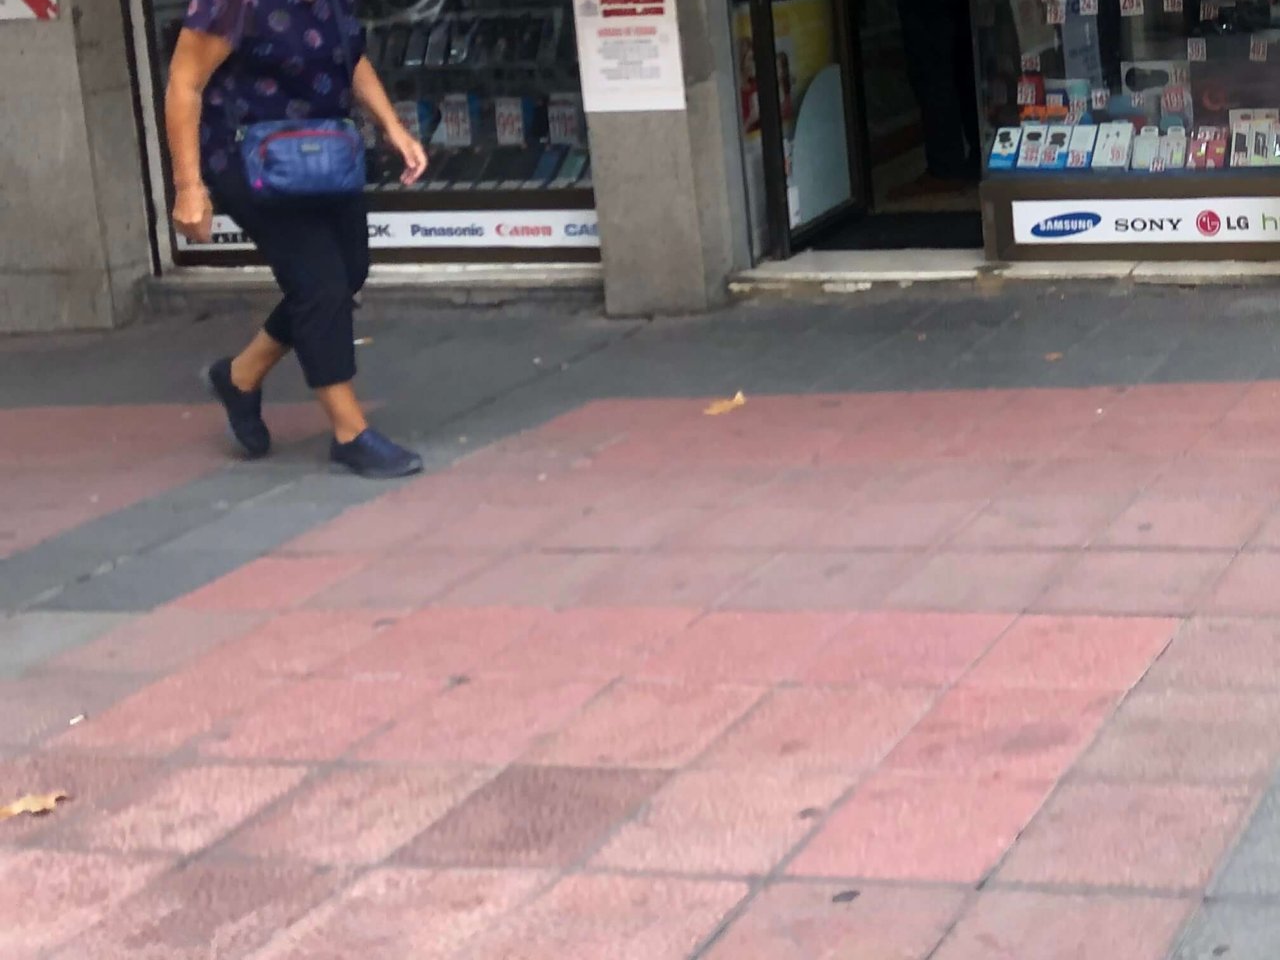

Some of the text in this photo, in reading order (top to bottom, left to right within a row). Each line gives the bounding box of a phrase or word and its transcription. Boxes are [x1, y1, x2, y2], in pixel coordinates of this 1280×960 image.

[410, 223, 484, 236] Panasonic
[495, 223, 552, 236] Canon
[1038, 217, 1093, 232] SAMSUNG
[1114, 218, 1182, 231] SONY
[1226, 216, 1249, 230] LG
